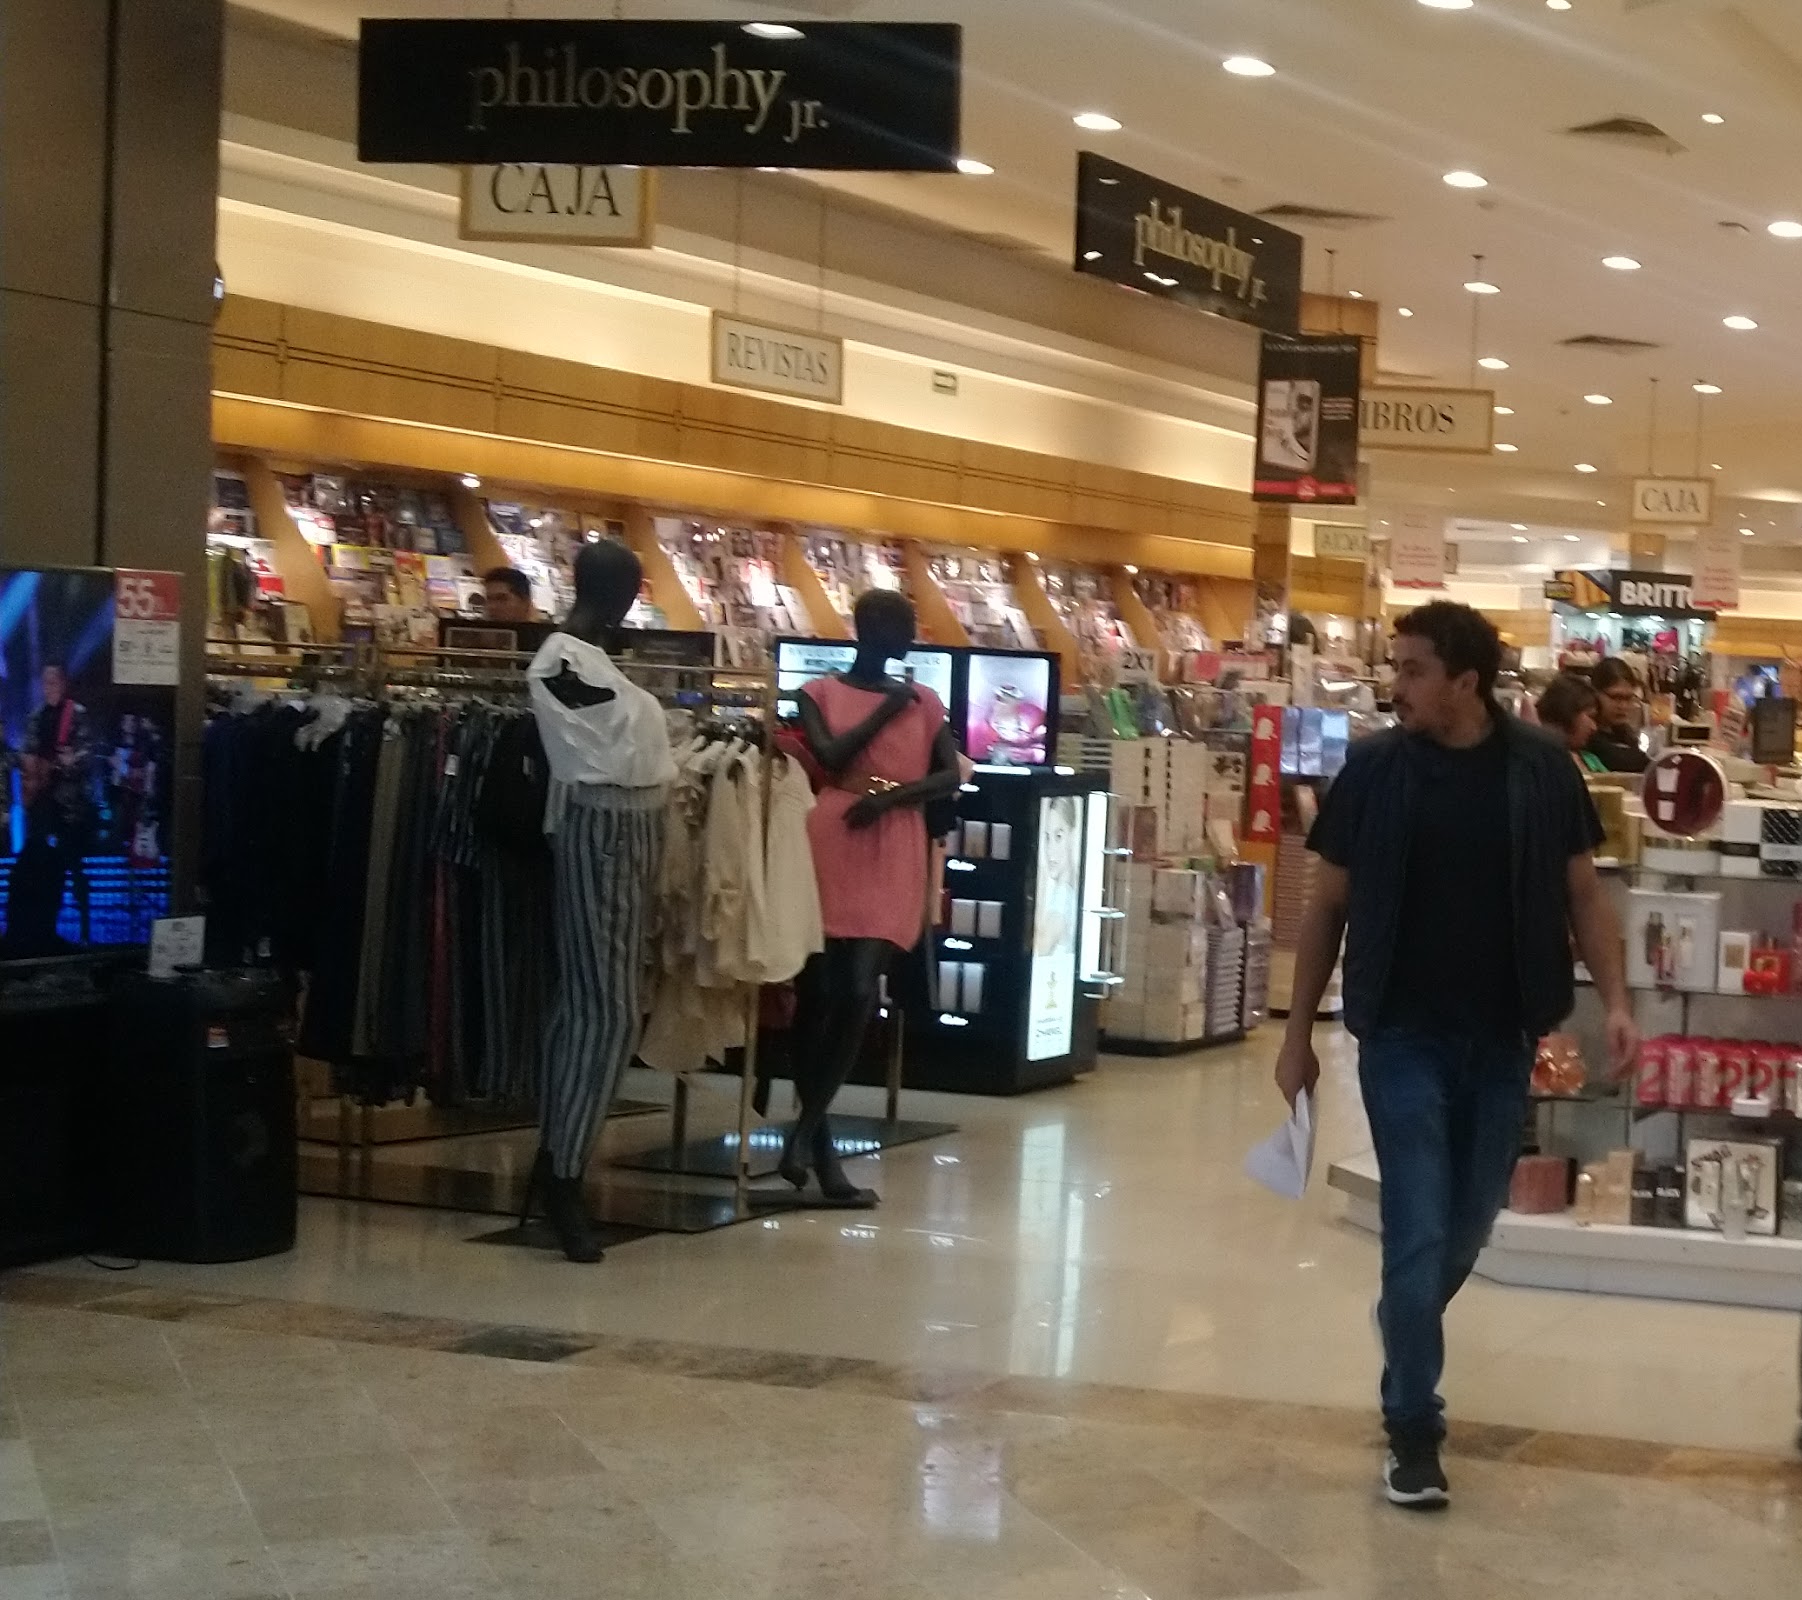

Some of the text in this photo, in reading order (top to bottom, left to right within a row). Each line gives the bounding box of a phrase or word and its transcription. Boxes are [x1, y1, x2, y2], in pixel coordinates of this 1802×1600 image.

[465, 41, 830, 143] philosophy jr.
[489, 166, 623, 218] CAJA
[1133, 197, 1256, 300] philosophy
[726, 331, 830, 386] REVISTAS
[1640, 486, 1702, 514] CAJA
[1619, 579, 1694, 610] BRITT
